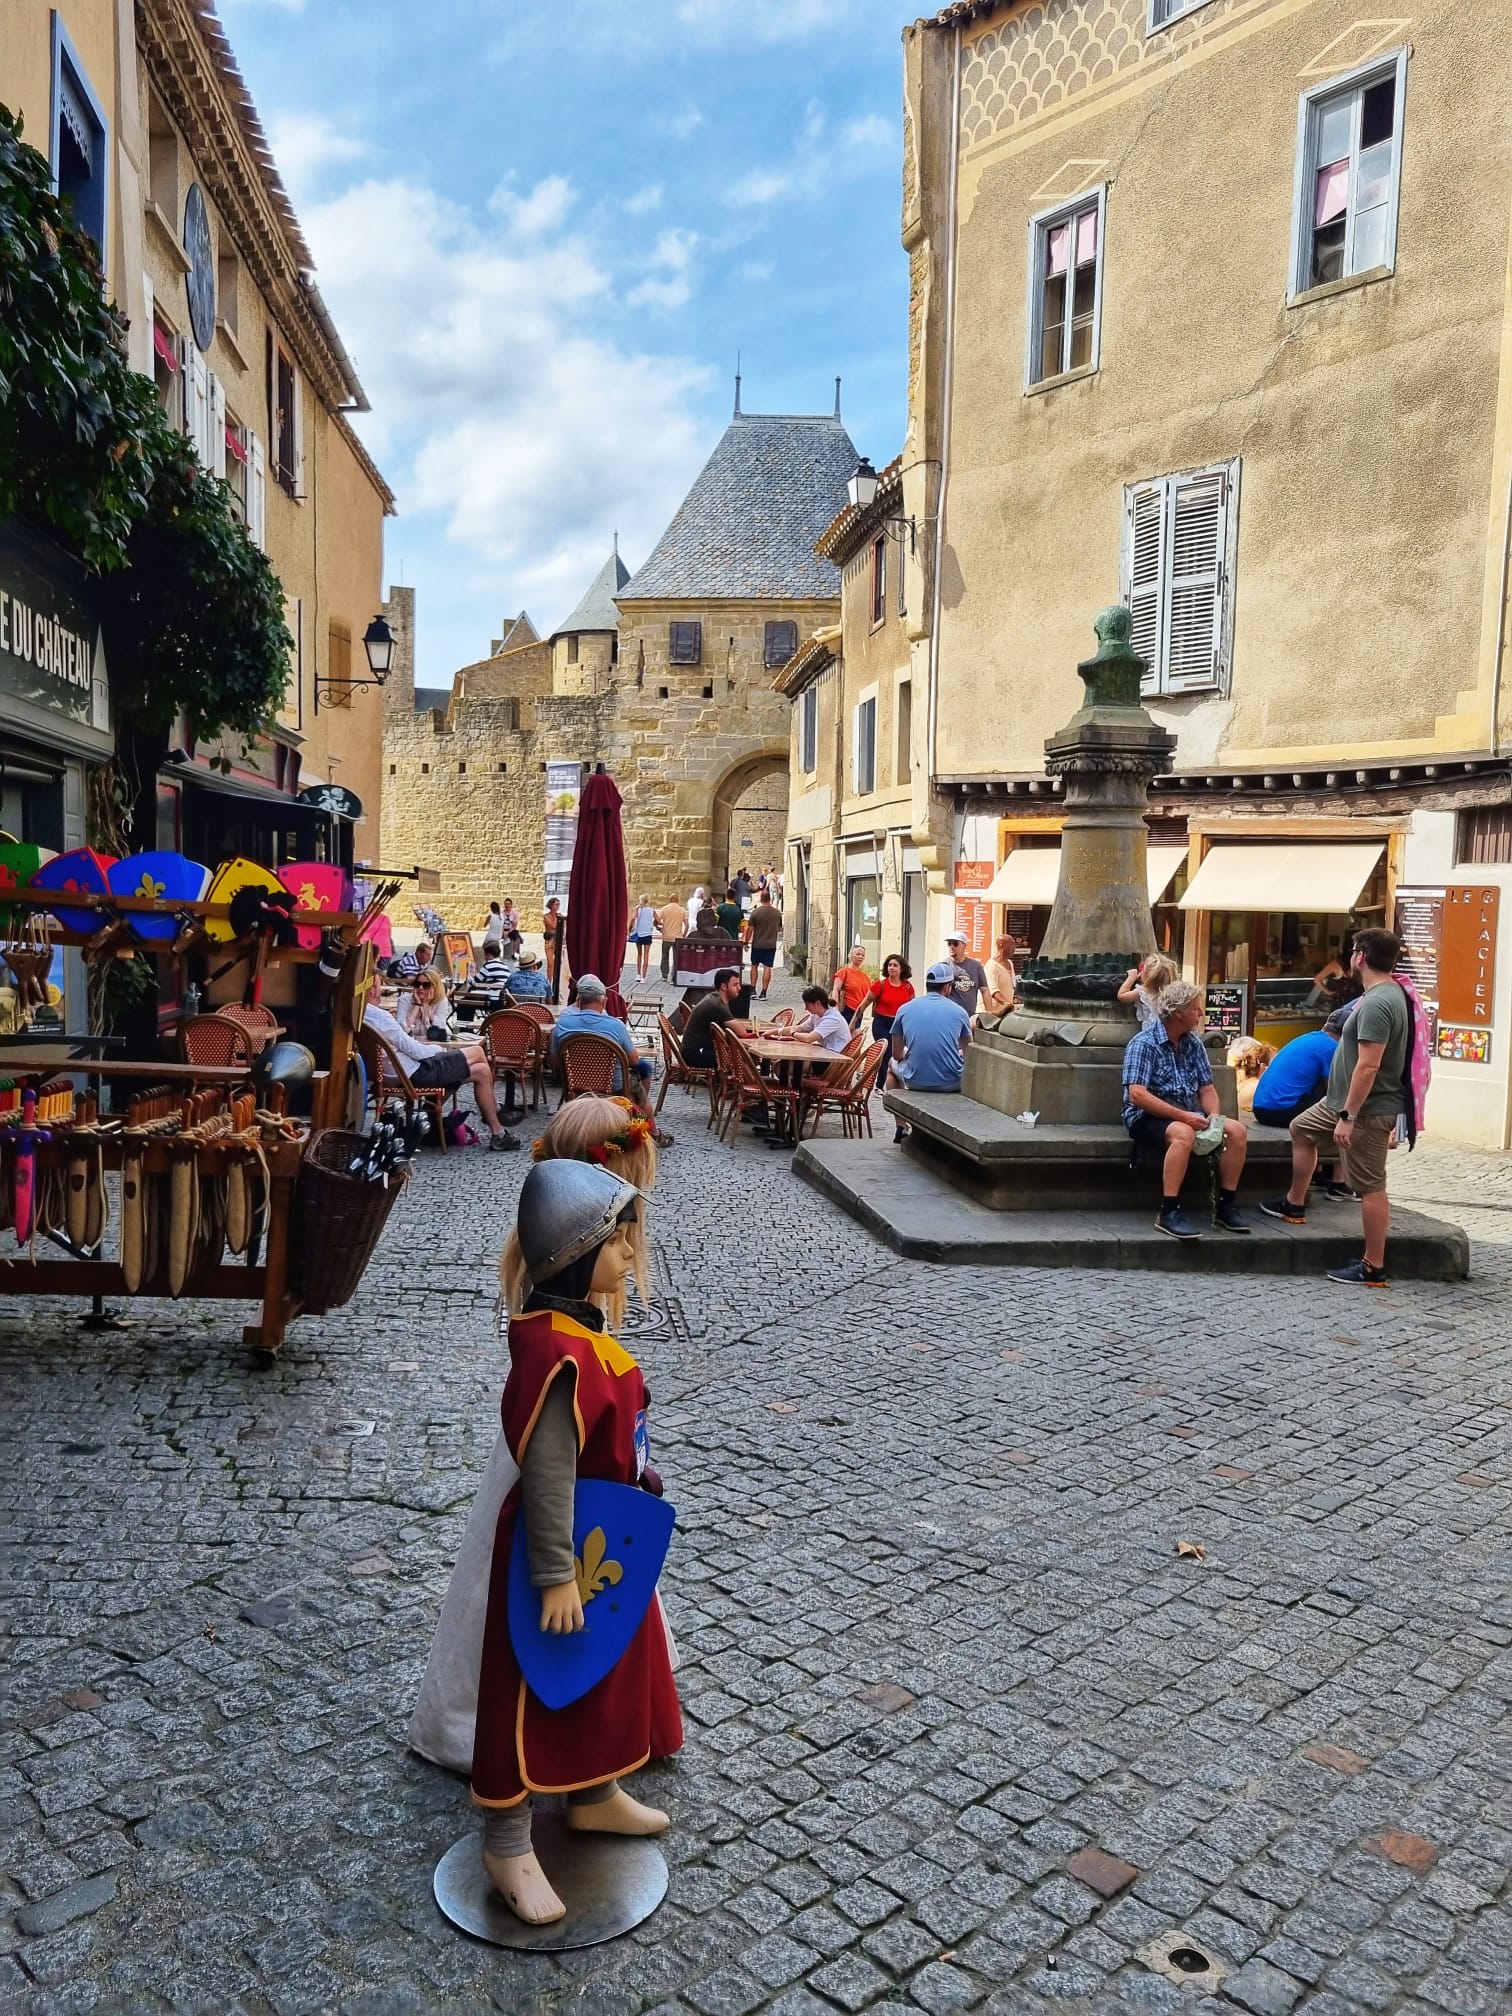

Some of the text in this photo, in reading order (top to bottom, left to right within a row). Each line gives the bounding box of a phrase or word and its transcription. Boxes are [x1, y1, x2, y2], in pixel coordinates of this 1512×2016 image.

[0, 590, 90, 691] E DU CHÂTEAU
[1451, 890, 1472, 903] LE
